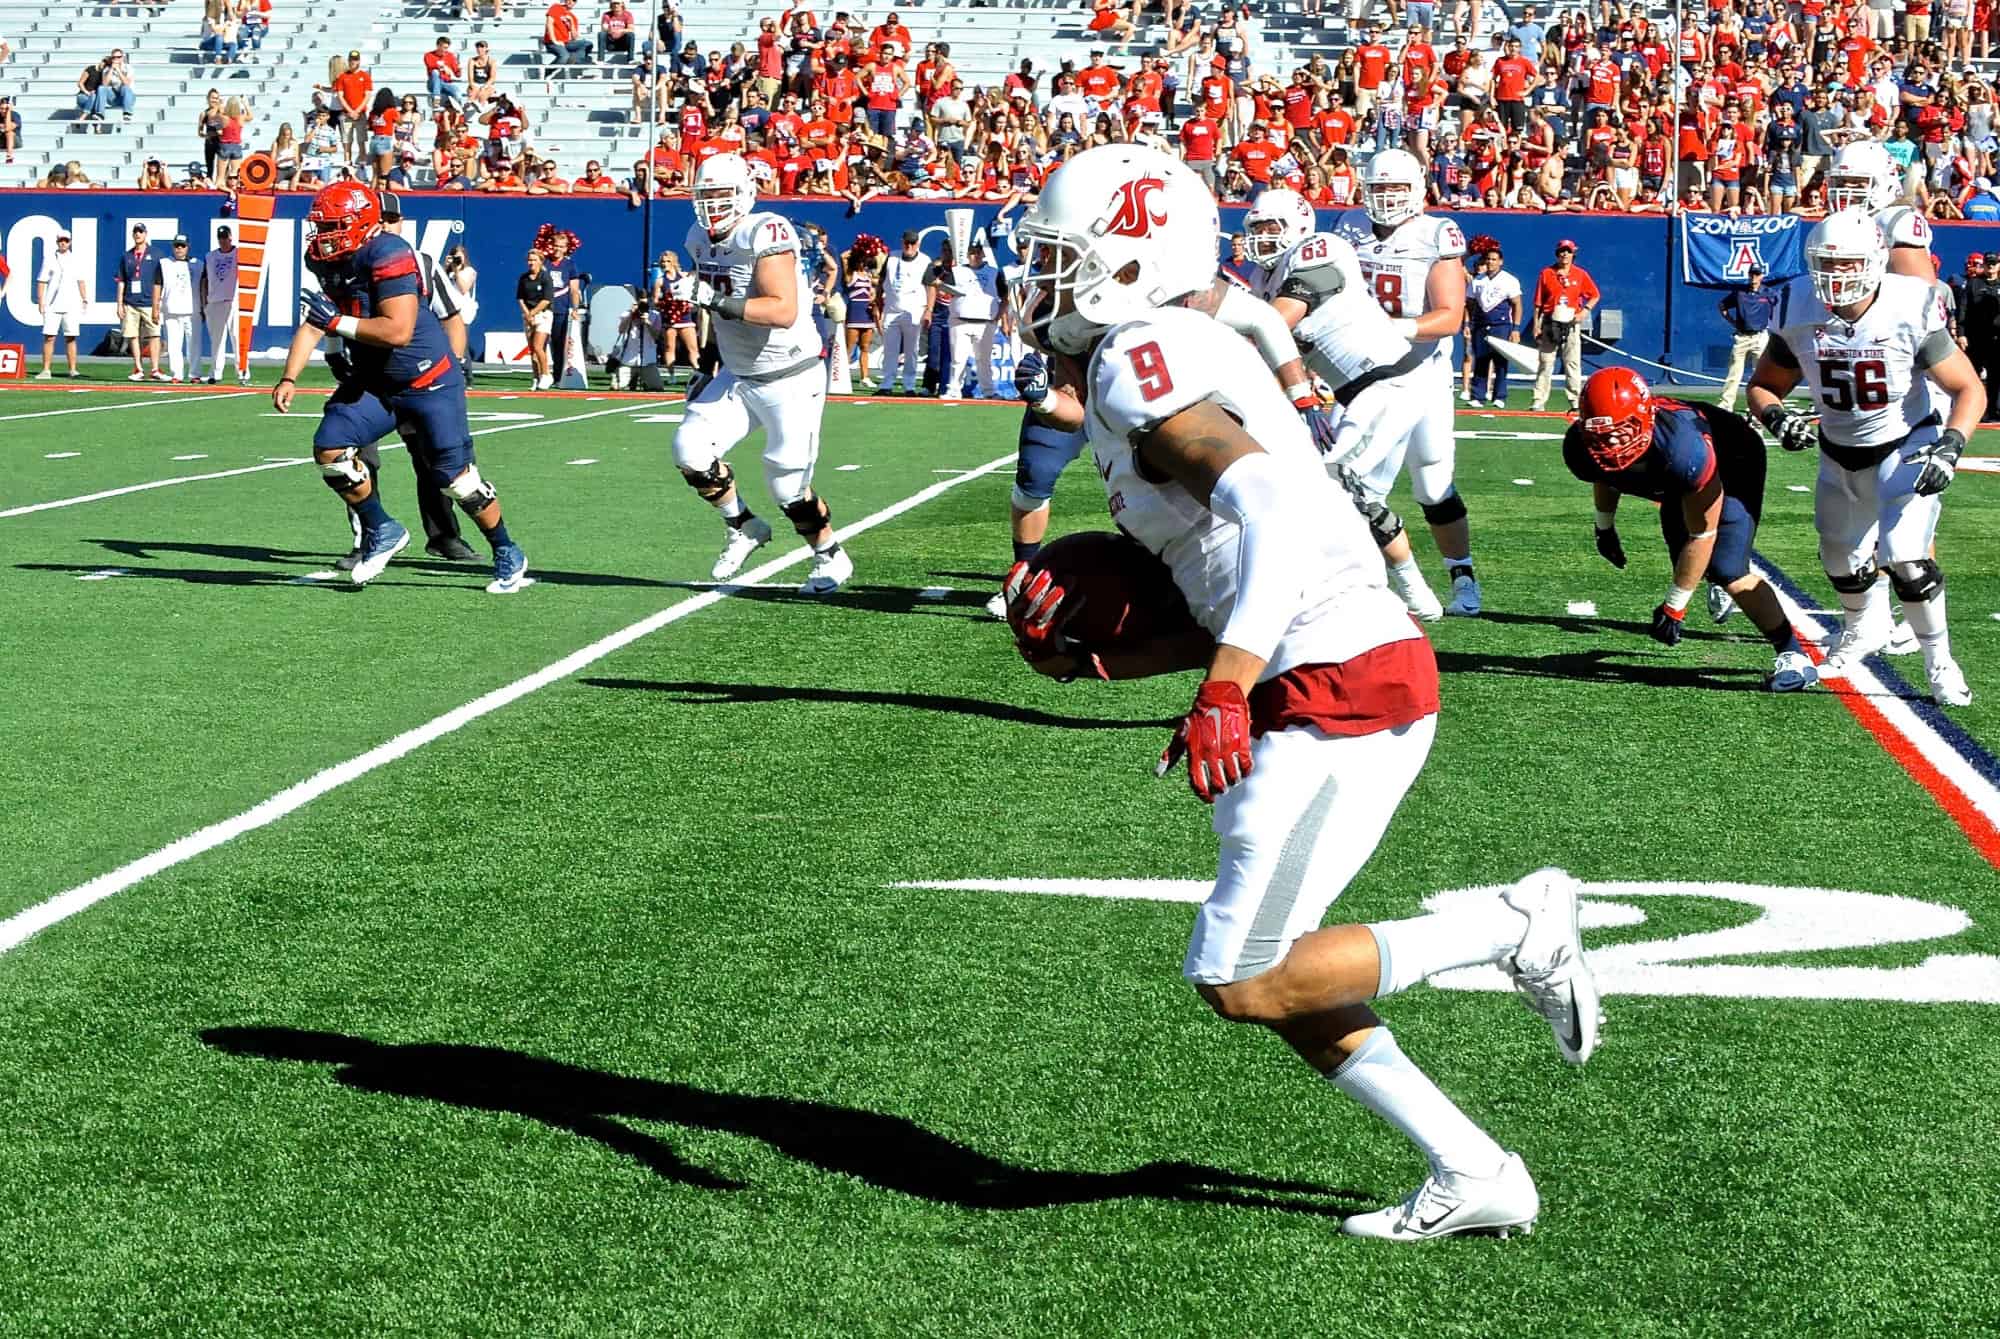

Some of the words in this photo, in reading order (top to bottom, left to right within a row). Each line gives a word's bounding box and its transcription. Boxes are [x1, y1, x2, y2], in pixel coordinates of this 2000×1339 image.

[1301, 239, 1327, 261] 63
[1125, 340, 1174, 402] 9
[1818, 359, 1889, 412] 56
